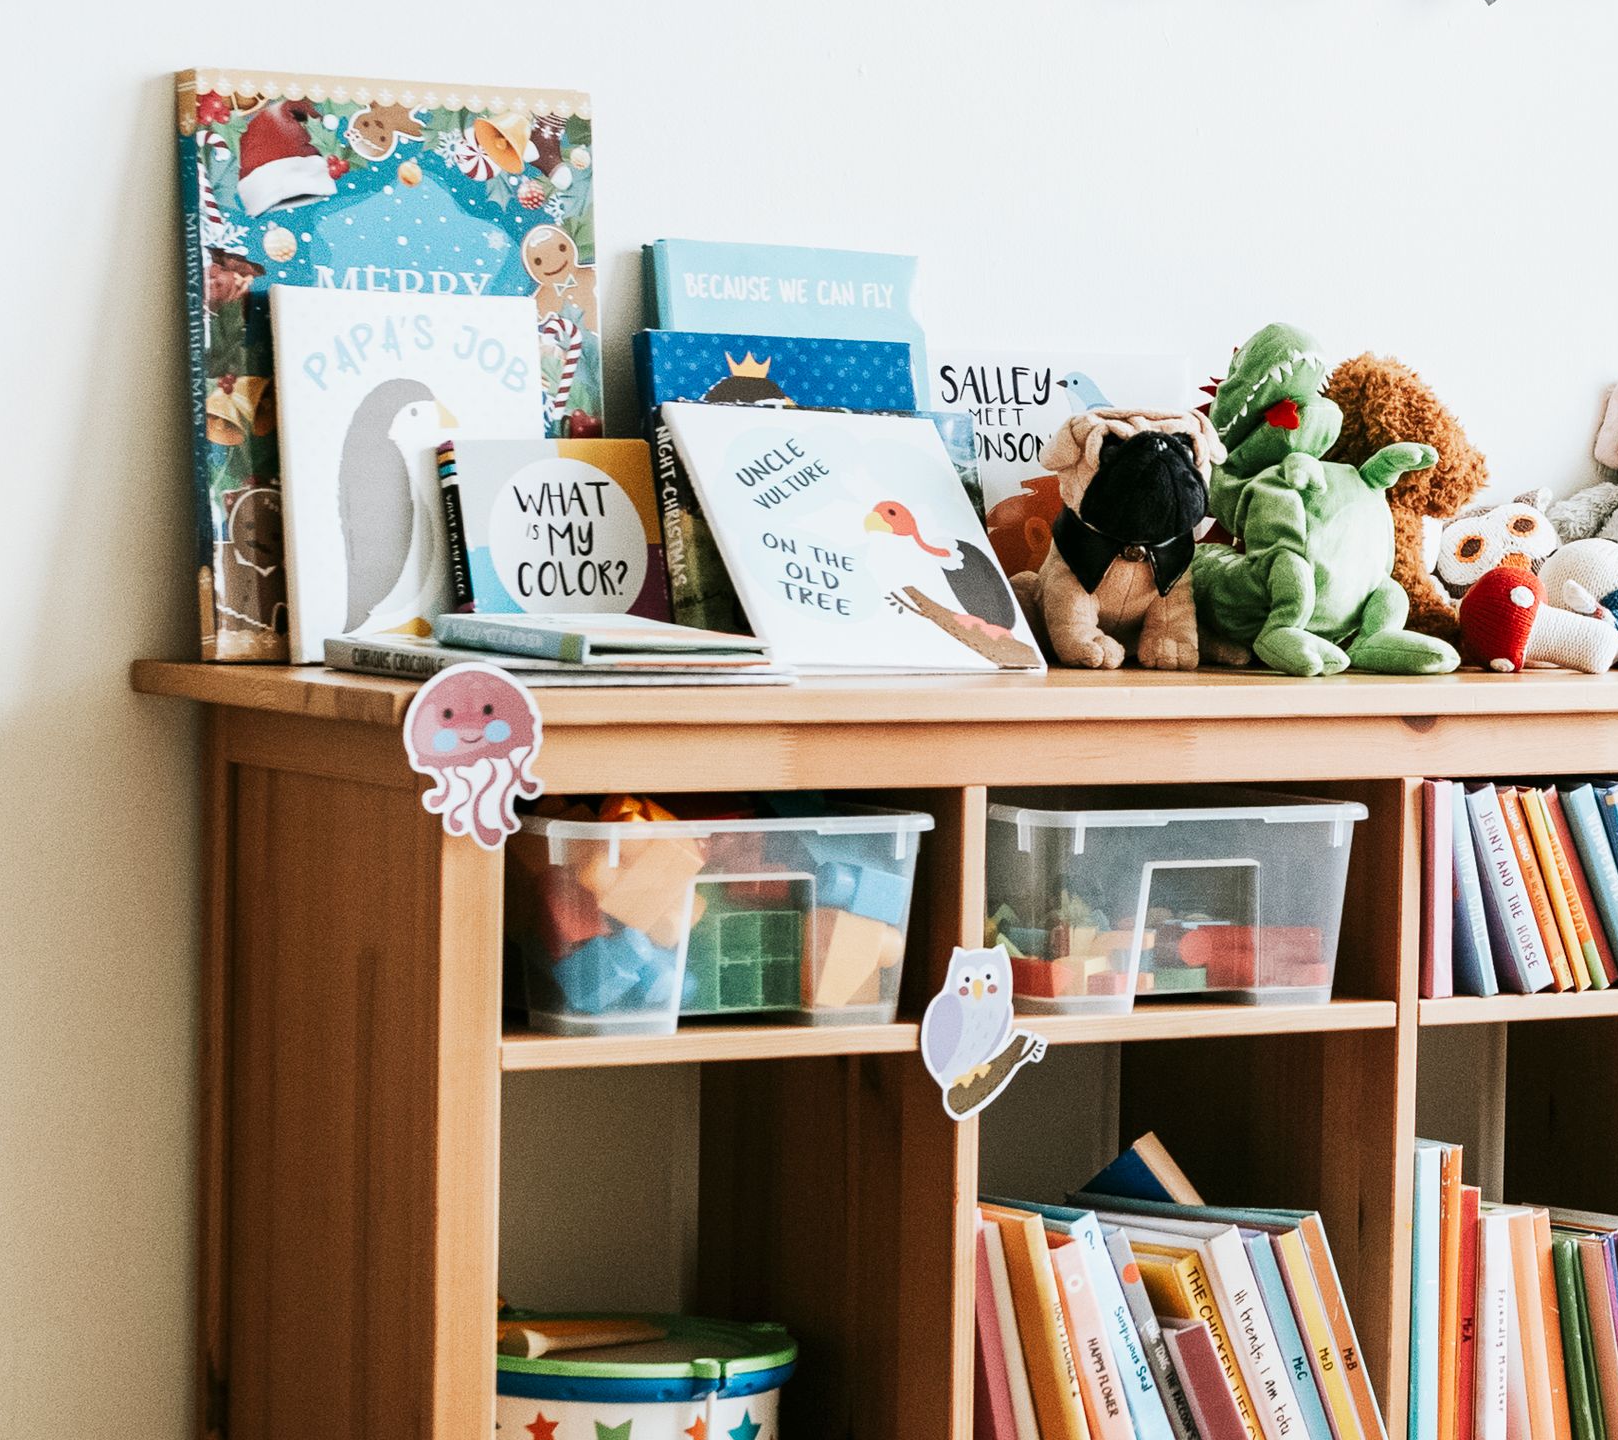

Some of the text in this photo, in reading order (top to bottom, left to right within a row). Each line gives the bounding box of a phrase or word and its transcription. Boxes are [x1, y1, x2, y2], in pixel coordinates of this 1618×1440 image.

[684, 273, 893, 309] BECAUSE WE CAN FLY
[303, 314, 529, 393] PAPA'S JOB
[940, 365, 1051, 405] SALLEY
[969, 408, 1023, 427] MEET
[735, 438, 806, 489] UNCLE
[514, 481, 610, 517] WHAT
[753, 459, 830, 511] VULTURE
[762, 532, 855, 573] ON THE
[517, 560, 629, 597] COLOR?
[785, 561, 839, 591] OLD
[778, 579, 851, 616] TREE
[1479, 811, 1504, 853] JENNY
[1497, 860, 1513, 887] AND
[1507, 894, 1524, 919] THE
[1516, 924, 1540, 969] HORSE
[1186, 1266, 1207, 1304] THE
[1114, 1306, 1153, 1393] Suspicious Seal
[1319, 1347, 1333, 1372] Mr.D
[1343, 1347, 1358, 1371] Mr.B
[1087, 1338, 1119, 1417] HAPPY FLOWER
[1292, 1356, 1308, 1381] Mr.C
